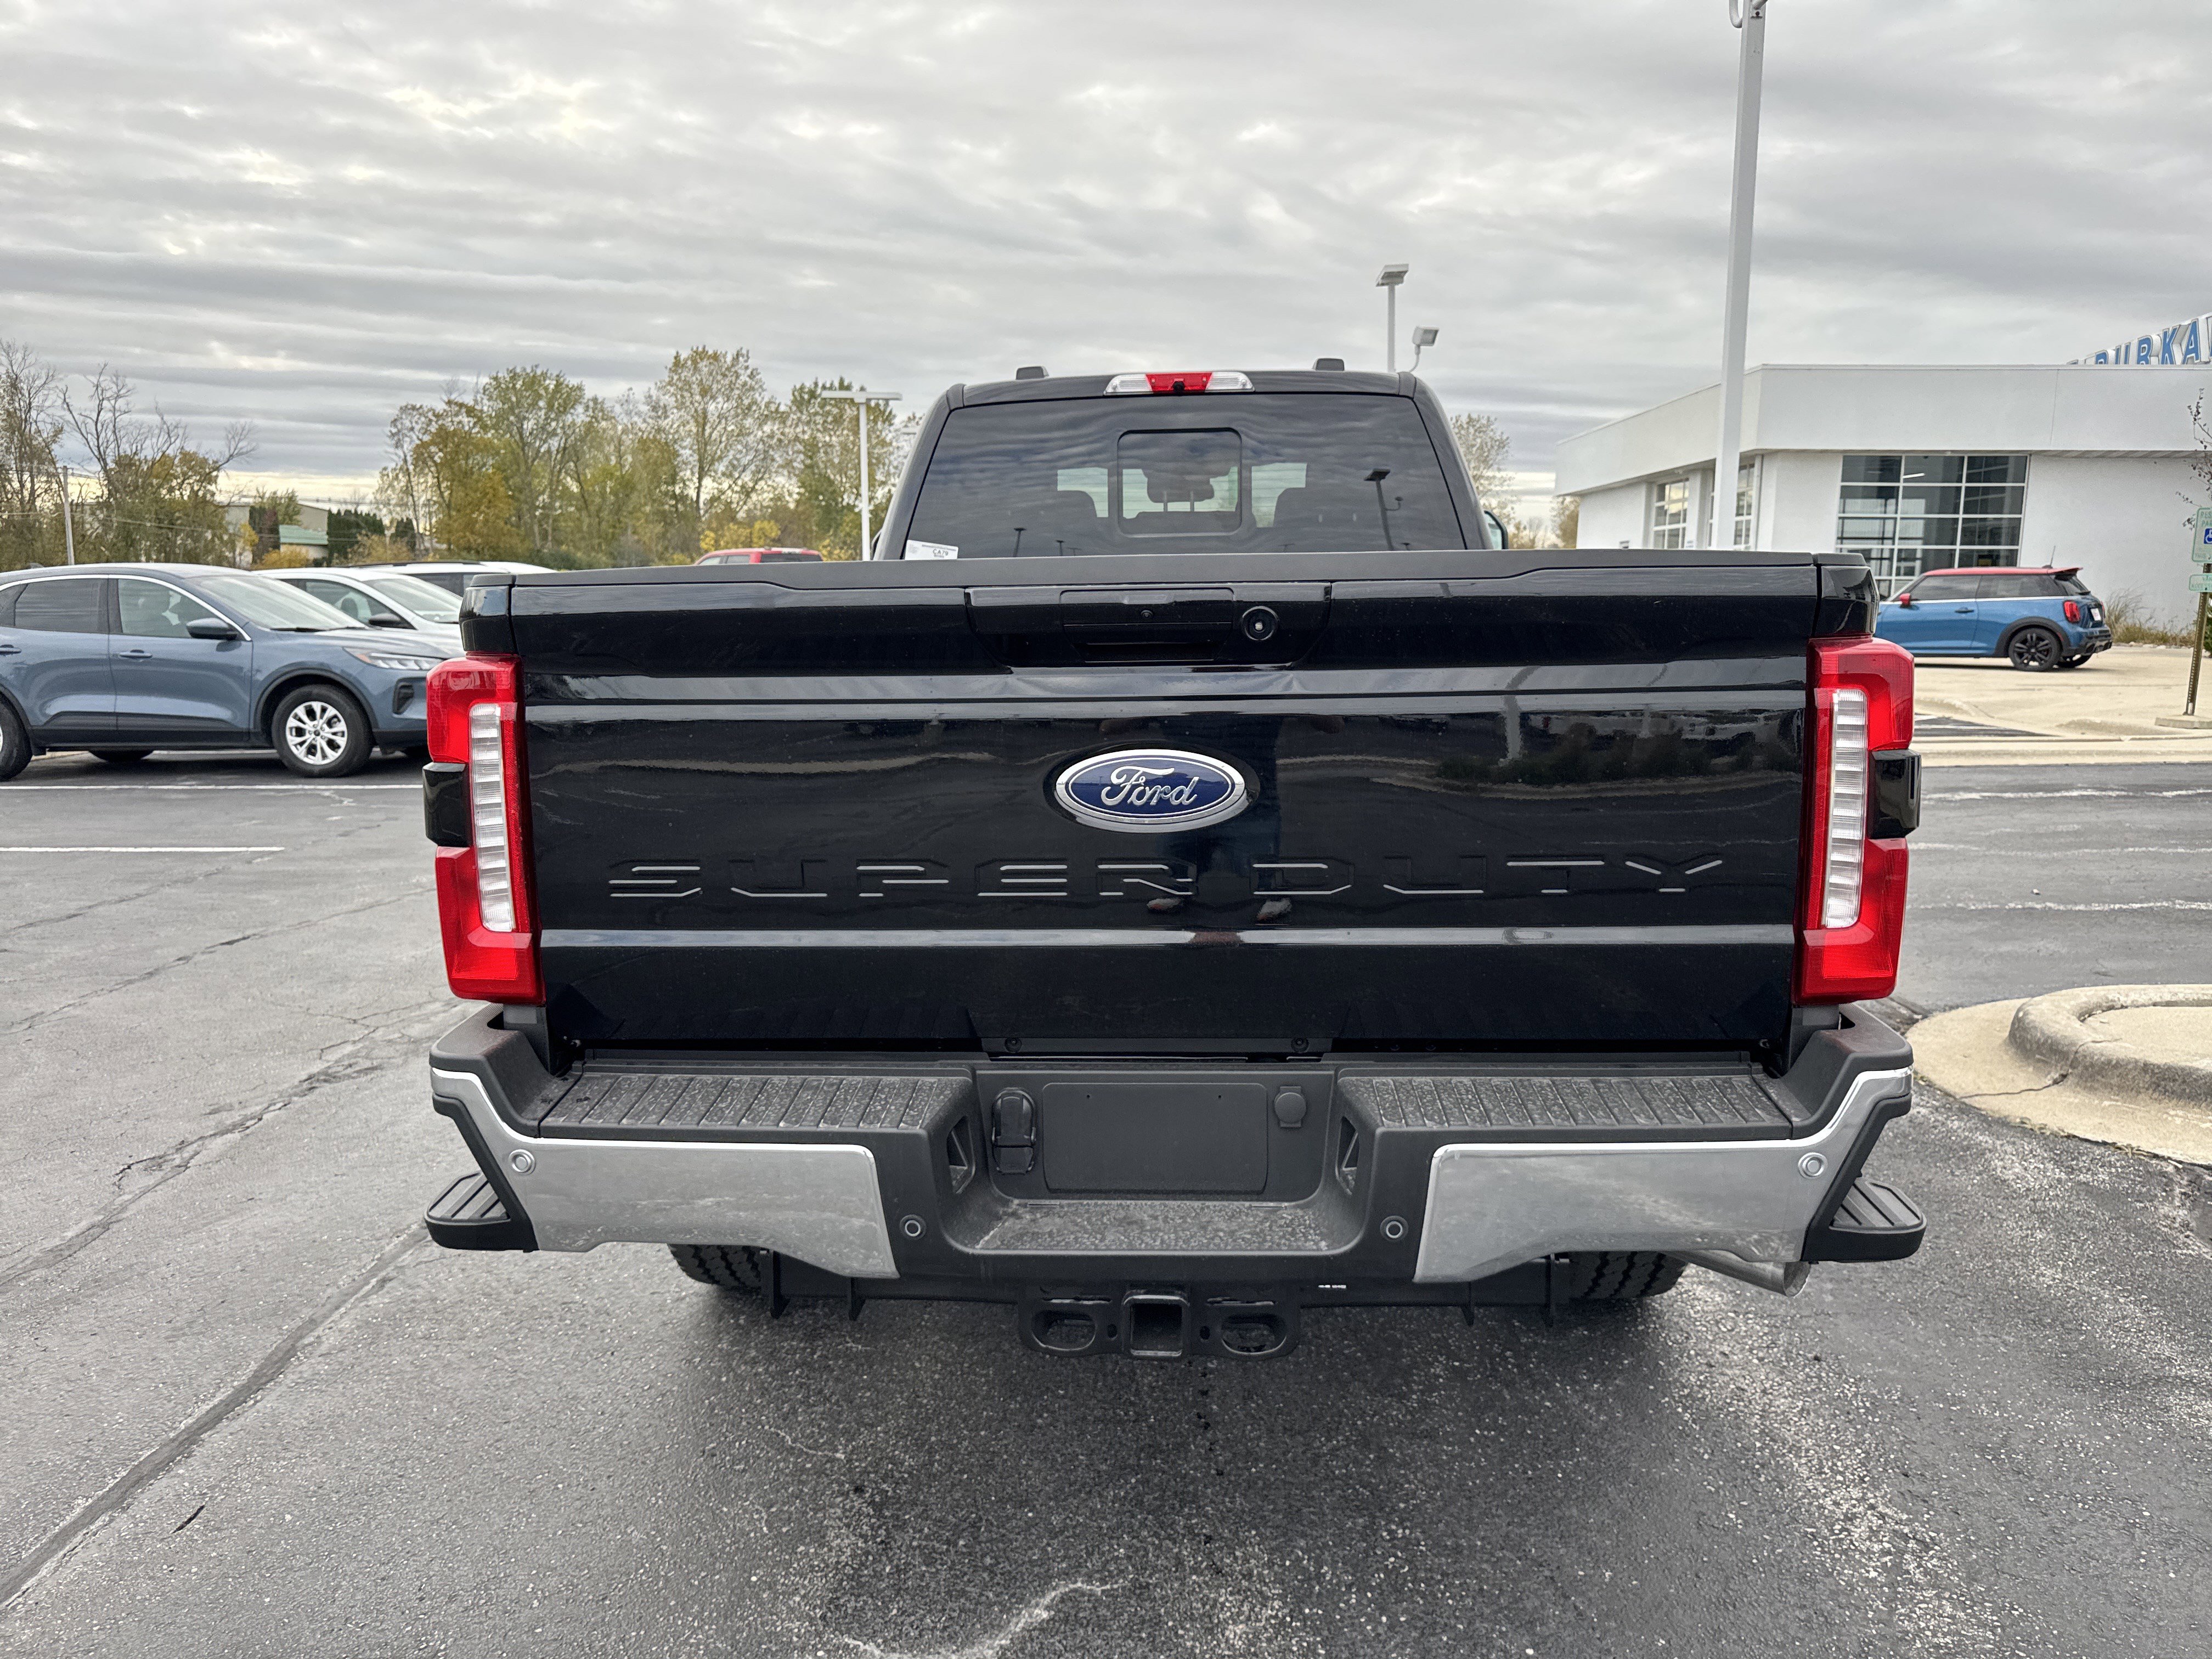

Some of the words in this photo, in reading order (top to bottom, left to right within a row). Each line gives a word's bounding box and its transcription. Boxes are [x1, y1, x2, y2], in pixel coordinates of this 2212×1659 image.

[1101, 765, 1200, 806] Ford
[608, 858, 1196, 899] SUPER
[1250, 854, 1724, 895] DUTY
